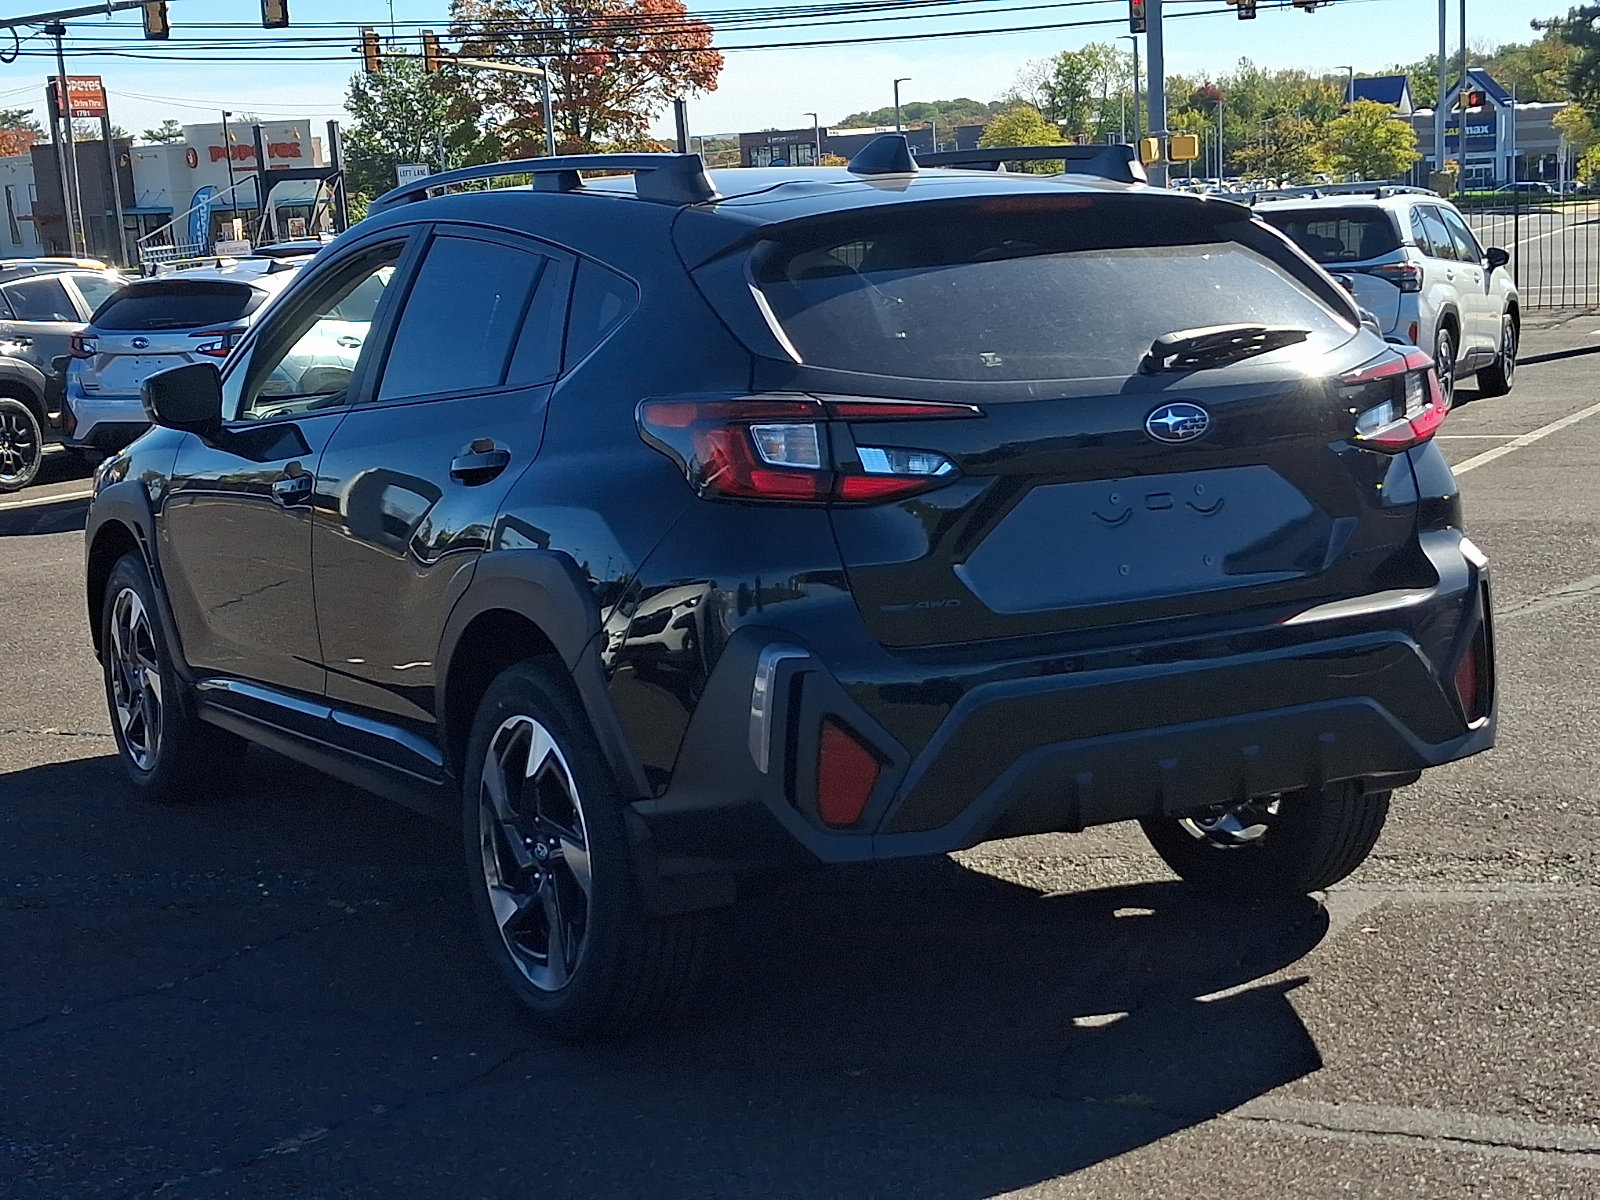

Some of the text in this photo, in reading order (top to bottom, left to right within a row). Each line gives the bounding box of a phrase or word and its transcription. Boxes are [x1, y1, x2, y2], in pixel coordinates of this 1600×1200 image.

[208, 142, 303, 162] POPYES
[399, 169, 412, 177] LEFT
[914, 598, 961, 609] AWD
